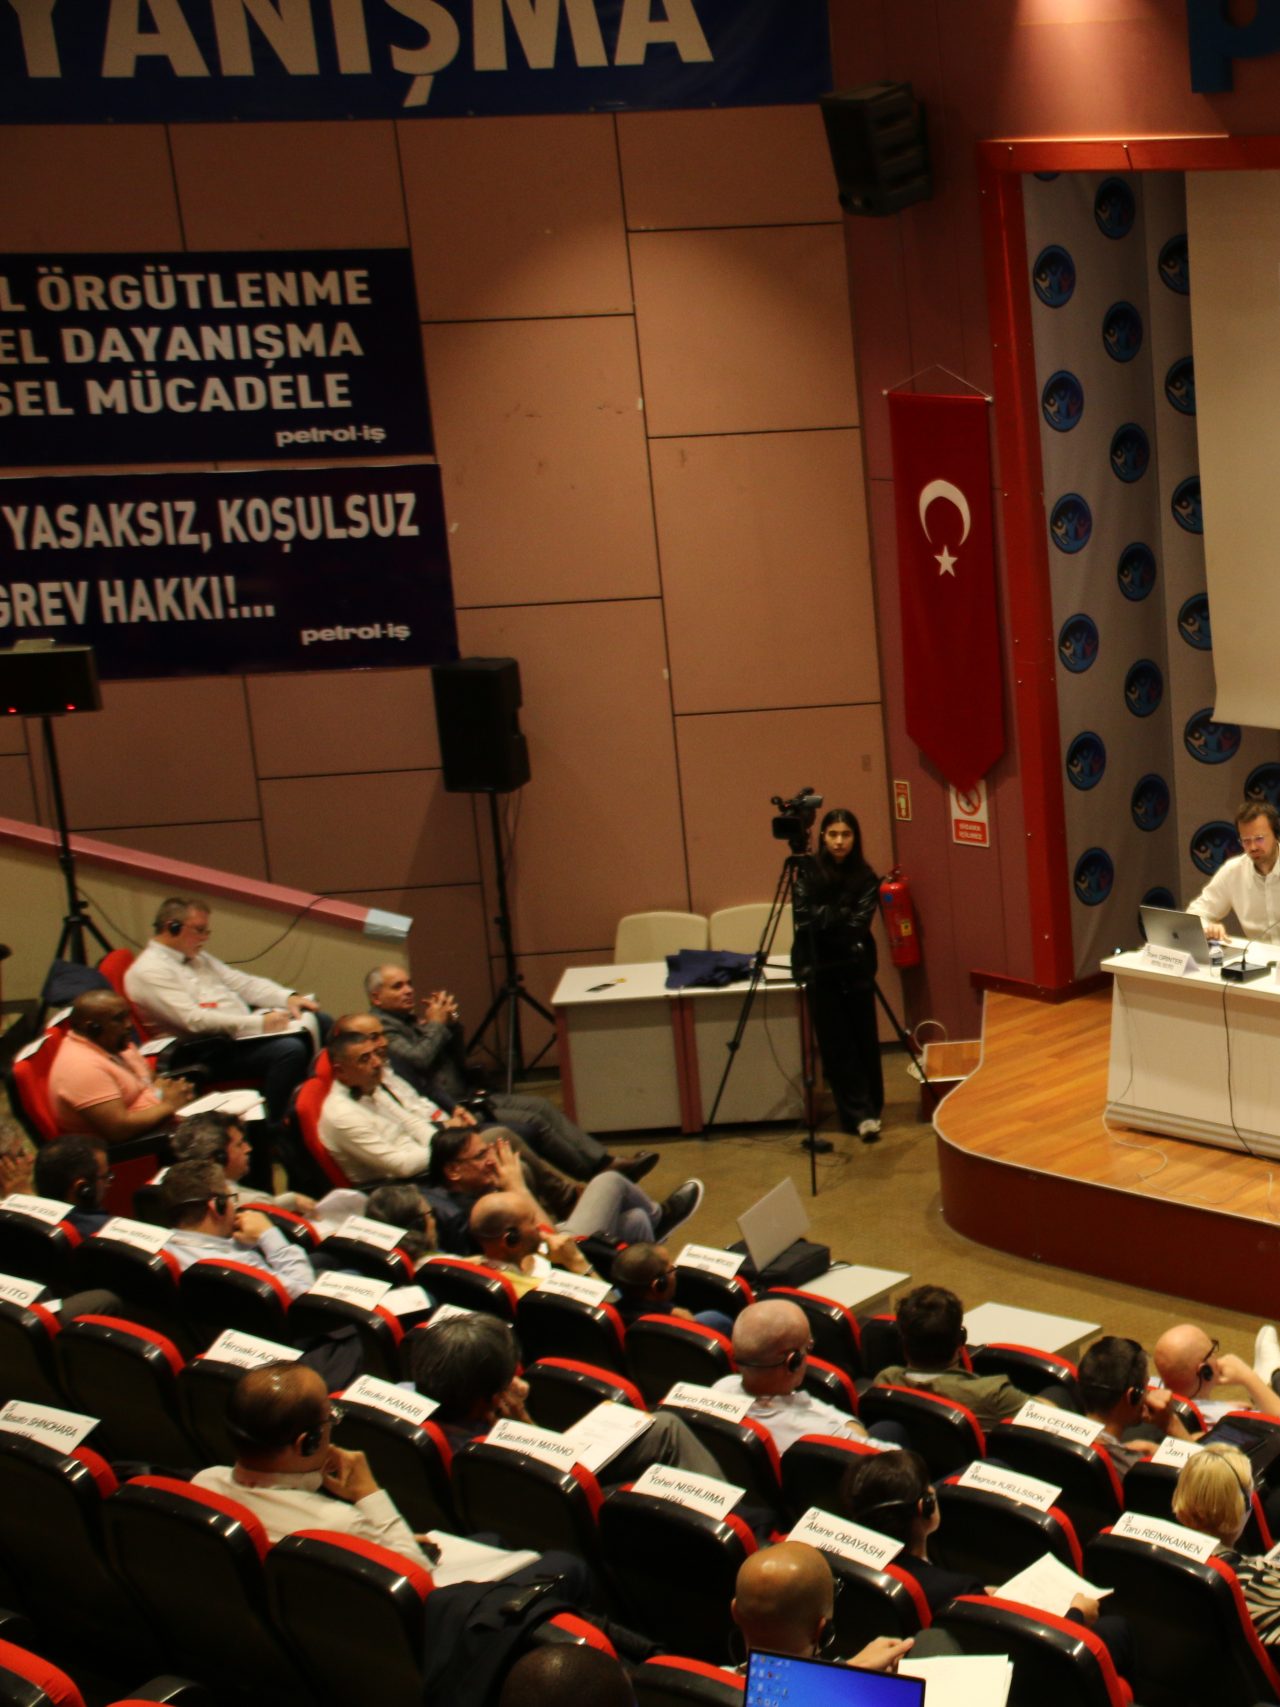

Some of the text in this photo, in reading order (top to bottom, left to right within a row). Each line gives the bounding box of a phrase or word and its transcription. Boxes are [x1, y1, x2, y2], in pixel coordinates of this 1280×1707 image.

[37, 266, 372, 312] ÖRGÜTLENME
[61, 322, 365, 369] DAYANIŞMA
[86, 370, 353, 415] MÜCADELE
[275, 425, 387, 447] petrol-iş
[3, 492, 421, 553] YASAKSIZ, KOŞULSUZ
[302, 623, 411, 645] petrol-iş
[385, 1395, 424, 1418] KANARI
[698, 1396, 741, 1415] ROUMEN
[1047, 1416, 1092, 1438] CEUNEN
[536, 1438, 575, 1457] MATANO
[676, 1479, 726, 1506] NISHIJIMA
[804, 1520, 888, 1560] Akane OBAYASHI
[1122, 1523, 1205, 1555] Taru REINIKAINEN
